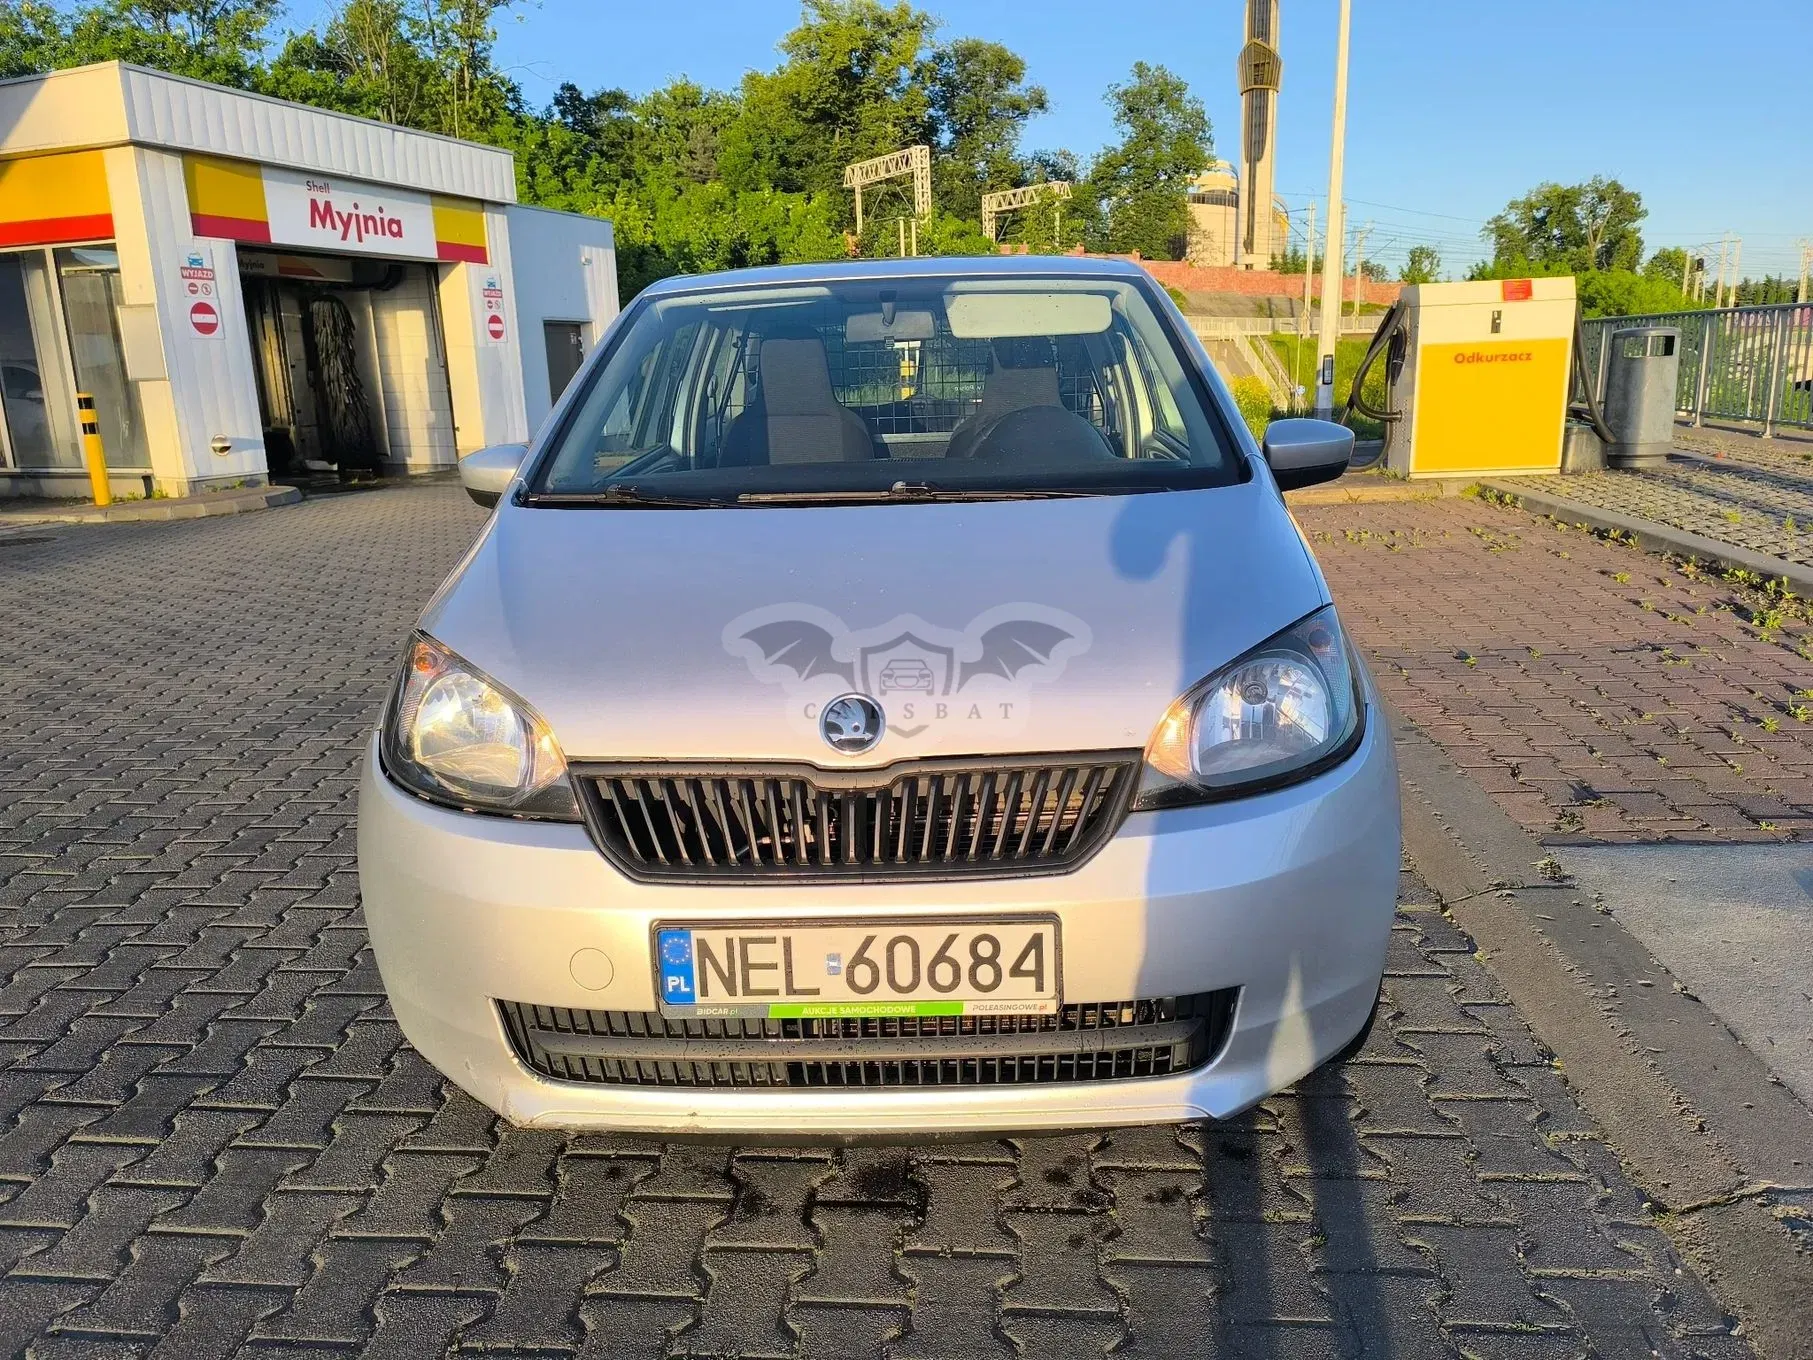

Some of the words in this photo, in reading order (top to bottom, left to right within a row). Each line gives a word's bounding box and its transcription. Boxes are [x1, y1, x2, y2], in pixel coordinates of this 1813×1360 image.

[306, 180, 330, 194] Shell
[309, 198, 403, 243] Myjnia
[181, 268, 214, 279] WYJAZD
[1454, 351, 1533, 364] Odkurzacz
[695, 935, 821, 997] NEL
[845, 932, 1045, 995] 60684
[667, 976, 691, 992] PL
[802, 1007, 838, 1015] AUKCJE
[839, 1005, 917, 1014] SAMOCHODOWE
